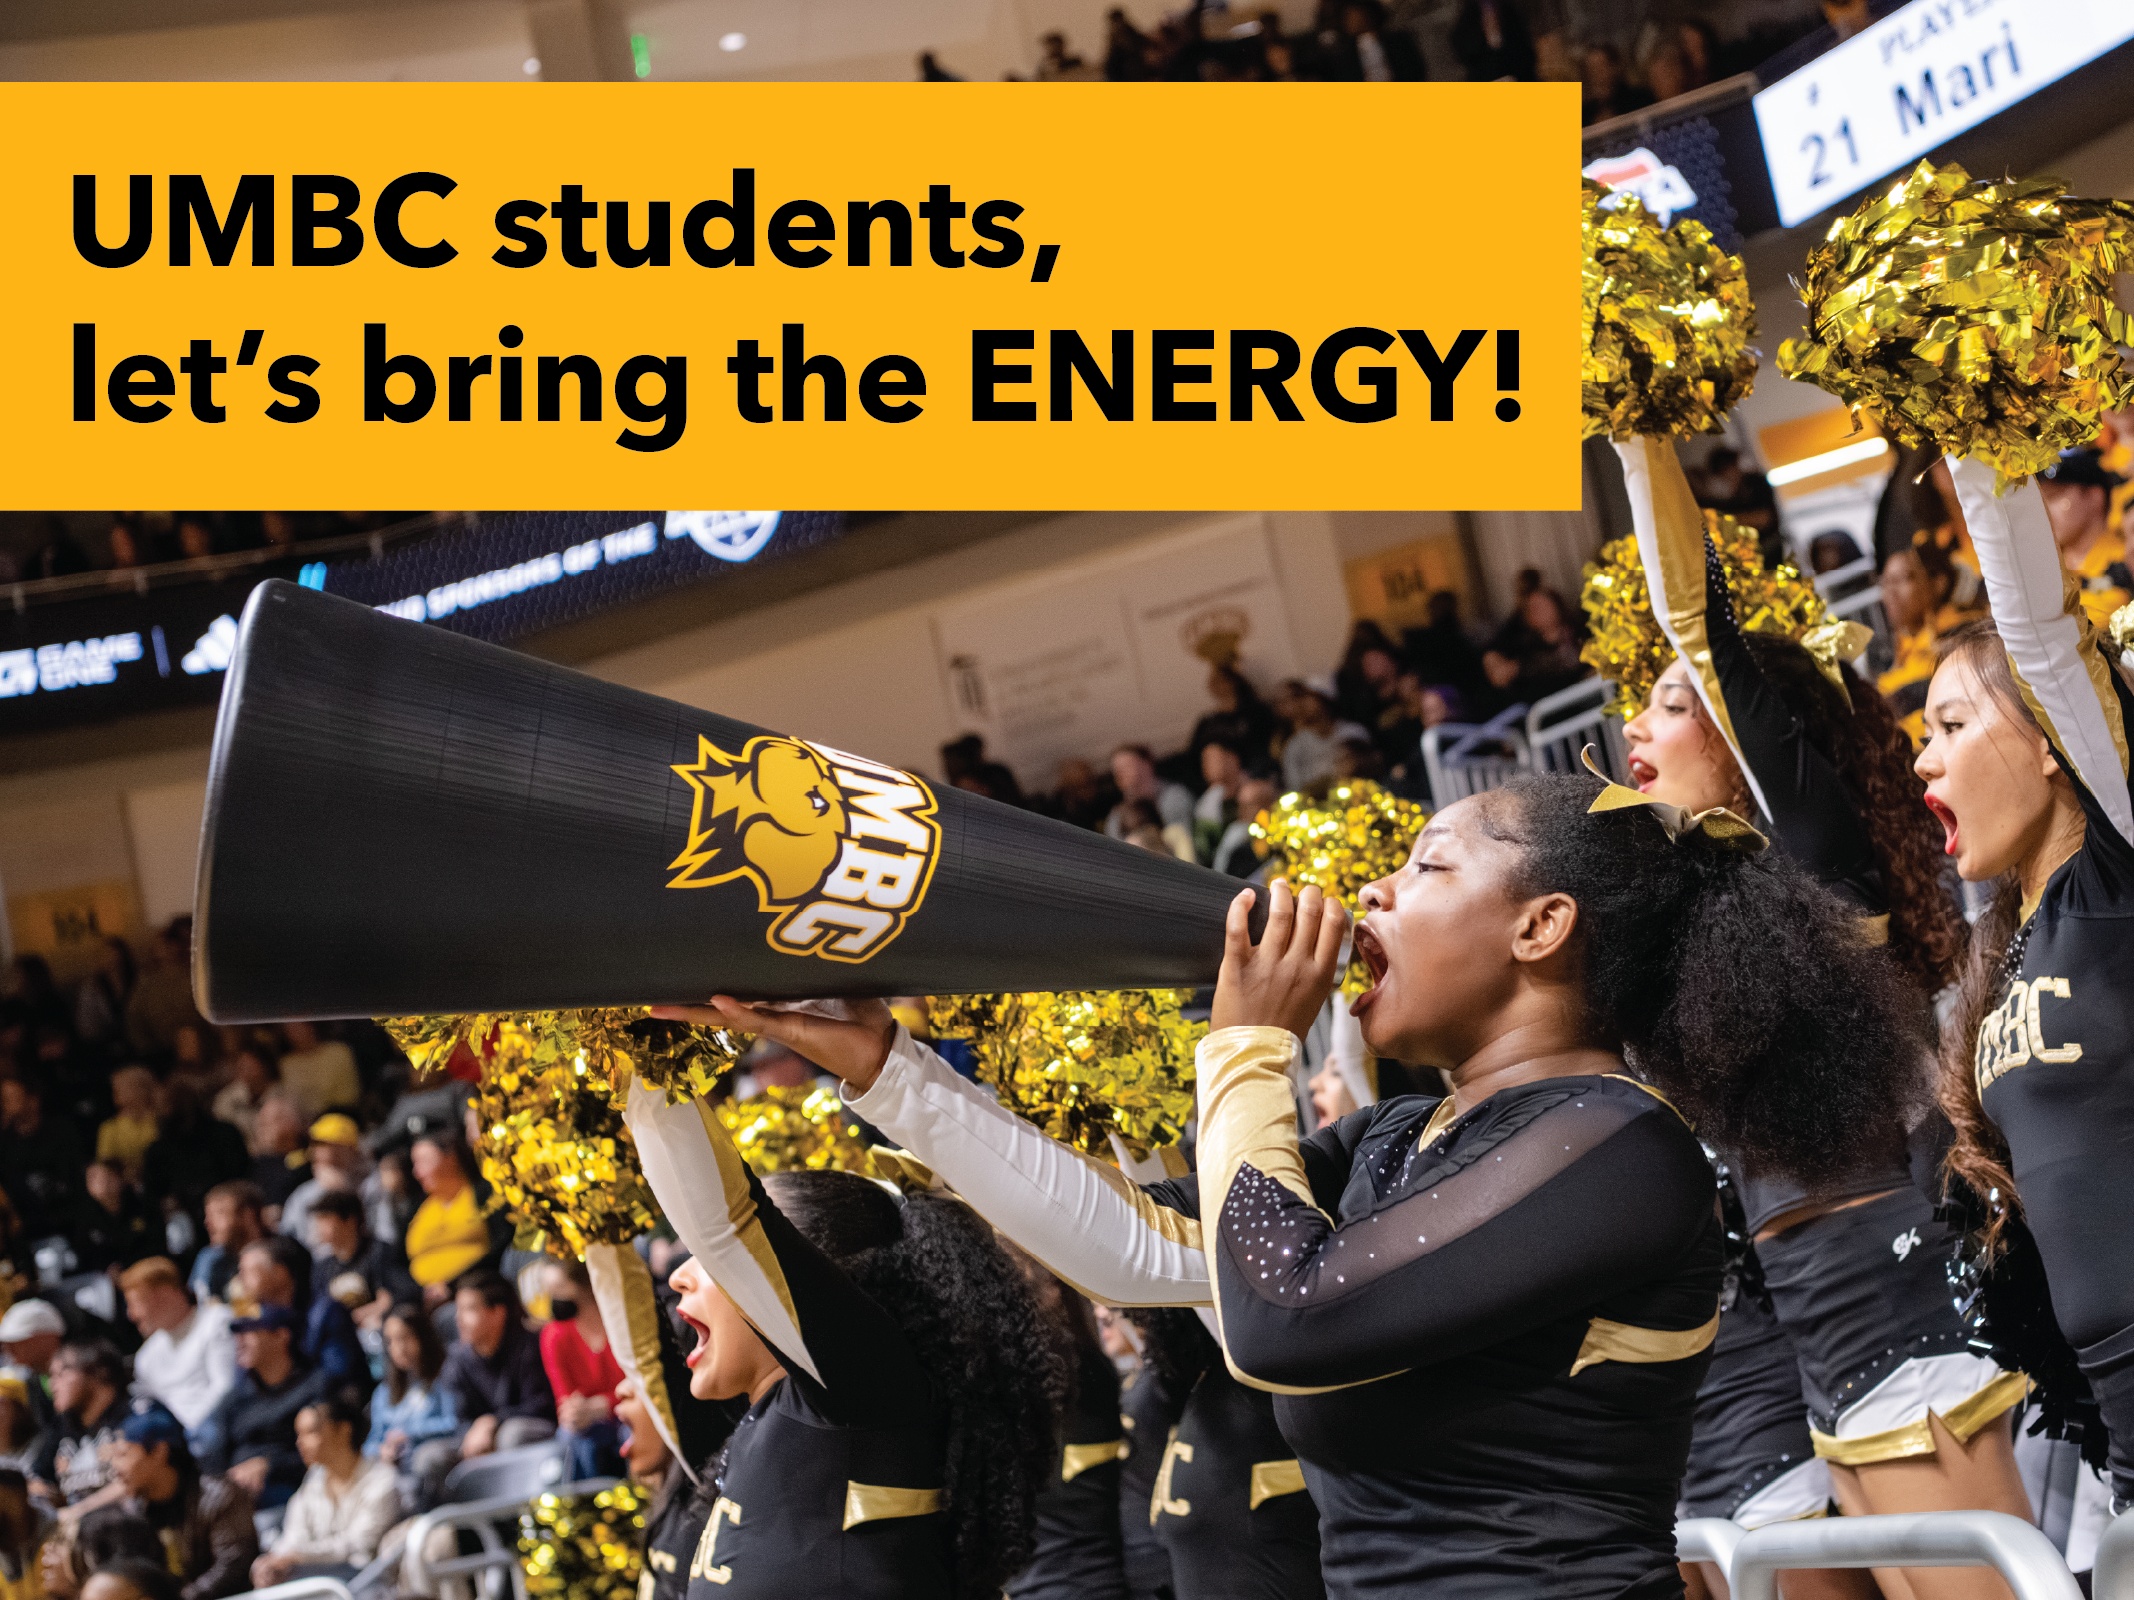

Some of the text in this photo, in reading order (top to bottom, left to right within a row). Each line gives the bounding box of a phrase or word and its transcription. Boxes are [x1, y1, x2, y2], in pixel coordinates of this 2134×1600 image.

[1800, 20, 2023, 190] 21 Mari
[427, 552, 563, 620] SPONSORS
[563, 540, 600, 576] OF
[601, 522, 658, 566] THE
[1975, 976, 2083, 1103] MBC
